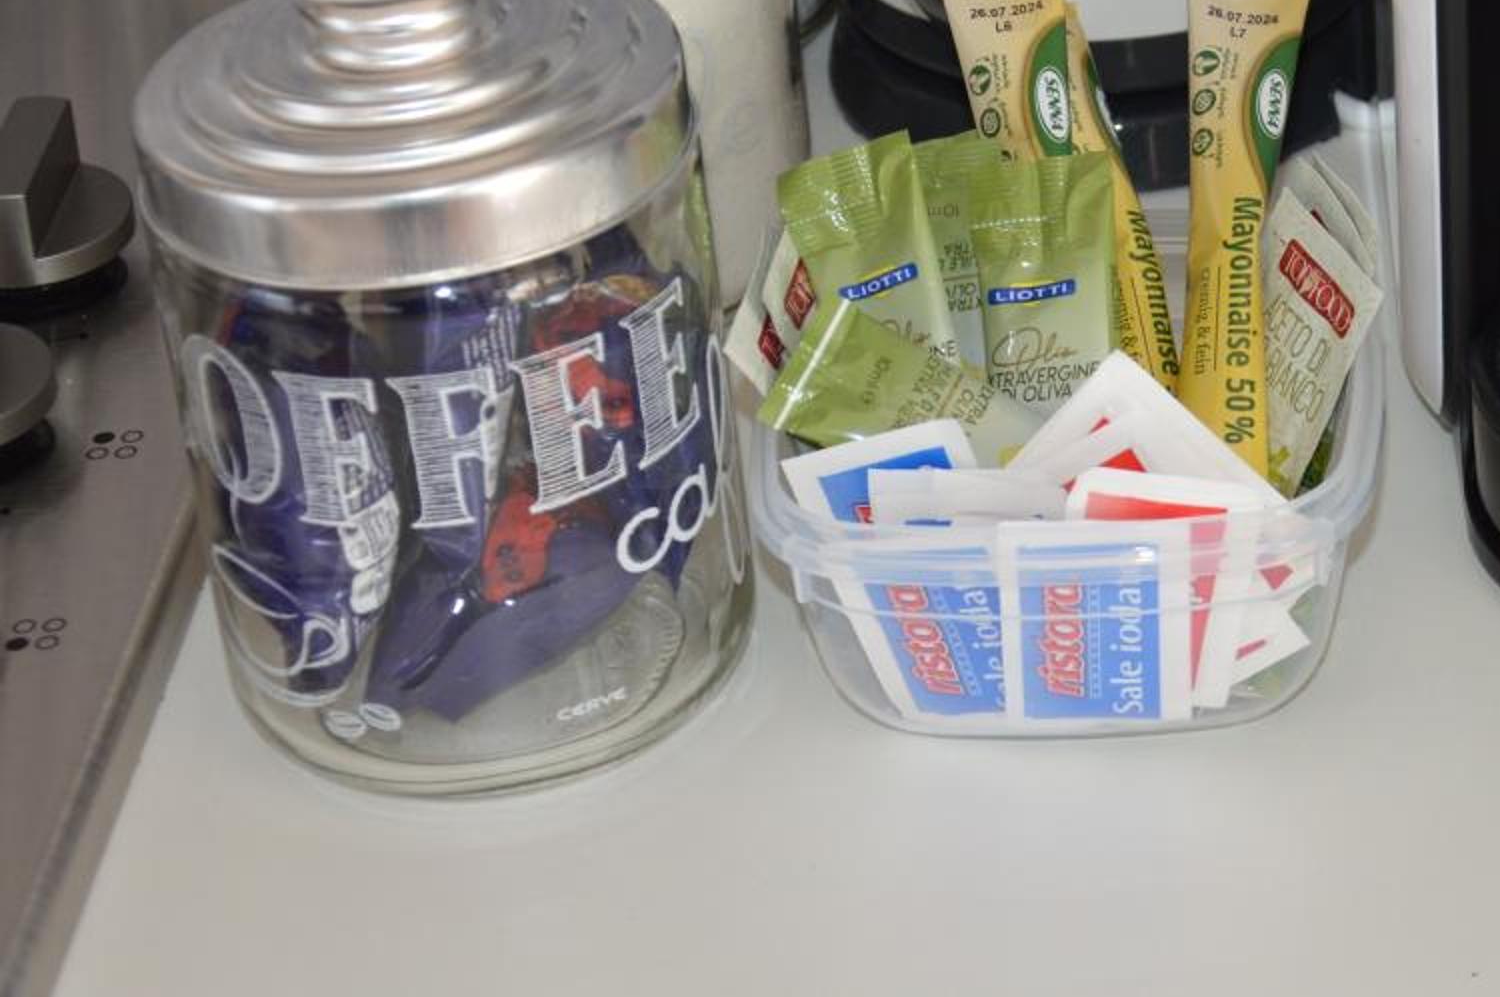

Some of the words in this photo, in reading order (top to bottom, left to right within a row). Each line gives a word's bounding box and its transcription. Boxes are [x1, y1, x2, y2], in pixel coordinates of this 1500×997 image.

[970, 0, 1044, 19] 26.07.2024
[1208, 6, 1280, 25] 26.07.2024
[1229, 27, 1247, 39] L7
[1043, 76, 1064, 132] SENNA
[1267, 77, 1285, 129] SENNA
[847, 267, 913, 299] LIOTTI
[994, 282, 1068, 302] LIOTTI
[1126, 209, 1181, 377] Mayonnaise
[1222, 196, 1263, 367] Mayonnaise
[1023, 382, 1073, 403] OLIVA
[1037, 581, 1085, 698] ristora
[1109, 660, 1144, 714] Sale
